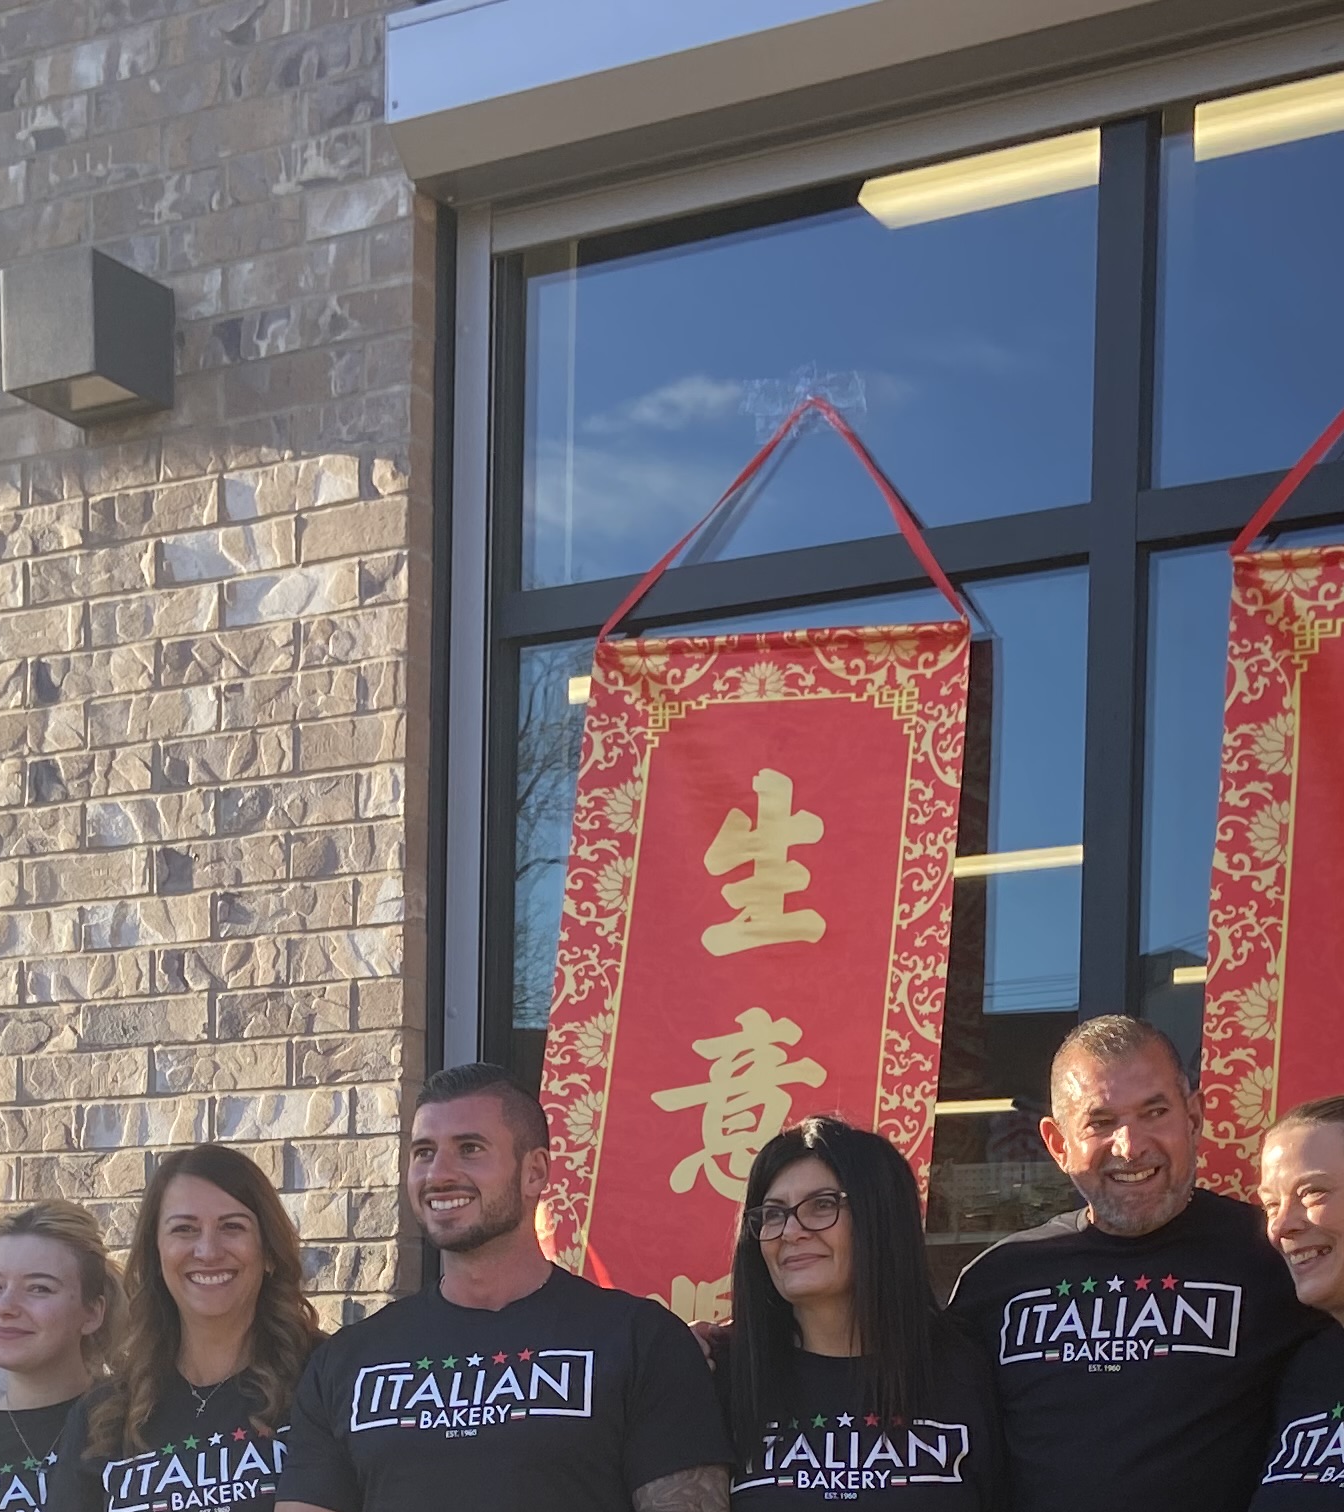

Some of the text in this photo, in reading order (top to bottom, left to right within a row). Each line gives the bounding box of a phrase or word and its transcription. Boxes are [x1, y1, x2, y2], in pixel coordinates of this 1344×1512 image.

[1016, 1292, 1217, 1347] ITALIAN
[1062, 1339, 1154, 1362] BAKERY
[369, 1362, 570, 1413] ITALIAN
[419, 1403, 511, 1430] BAKERY
[745, 1430, 947, 1475] TALIAN
[171, 1478, 260, 1512] BAKERY
[797, 1469, 891, 1490] BAKERY
